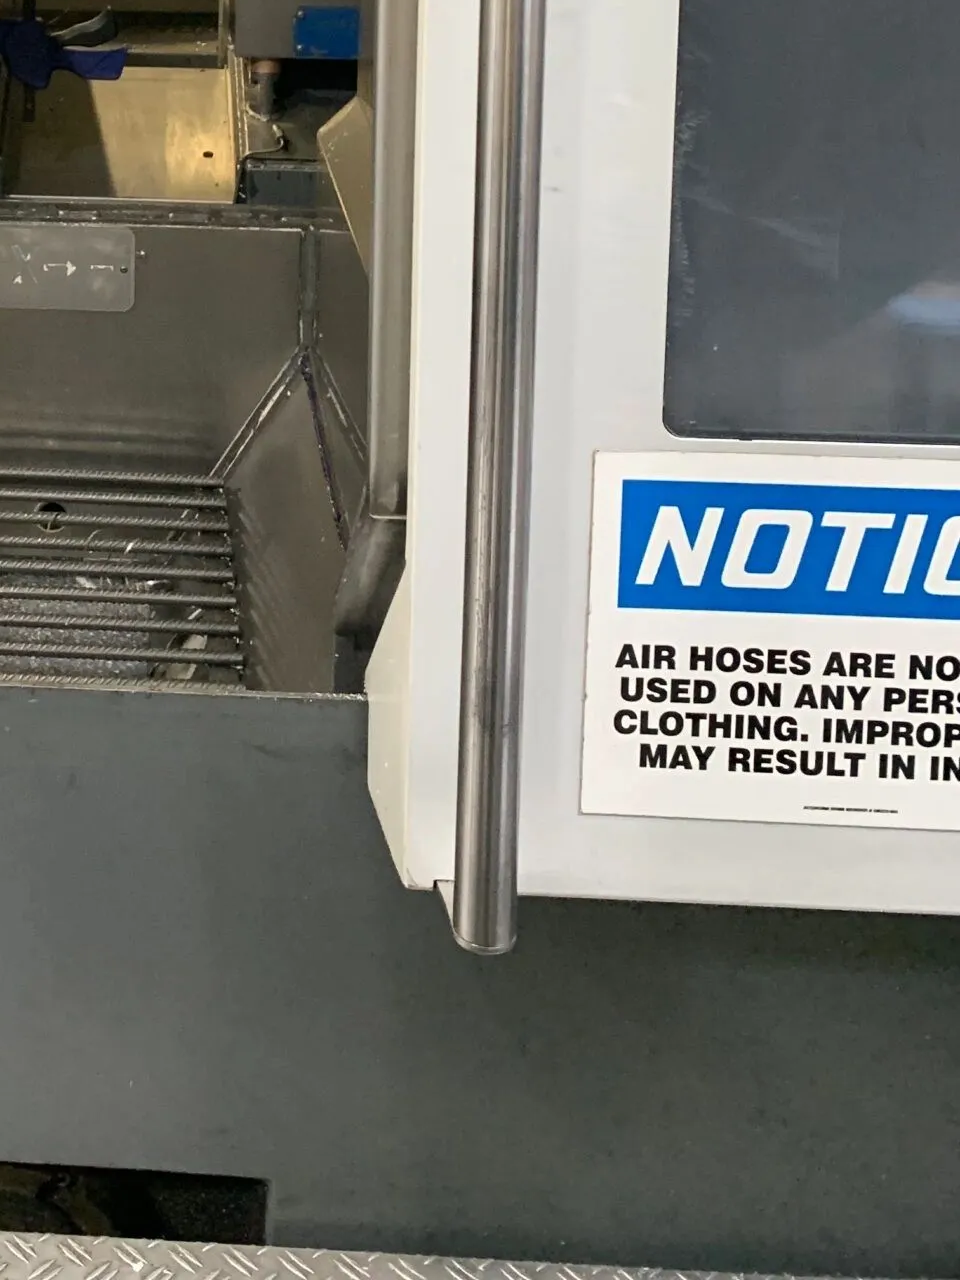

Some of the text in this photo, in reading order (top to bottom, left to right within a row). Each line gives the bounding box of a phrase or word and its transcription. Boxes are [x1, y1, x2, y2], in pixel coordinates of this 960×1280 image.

[615, 643, 960, 682] AIR HOSES ARE NO
[620, 676, 960, 715] USED ON ANY PER
[613, 708, 809, 742] CLOTHING.
[639, 743, 716, 771] MAY
[727, 746, 866, 777] RESULT
[878, 753, 916, 780] IN
